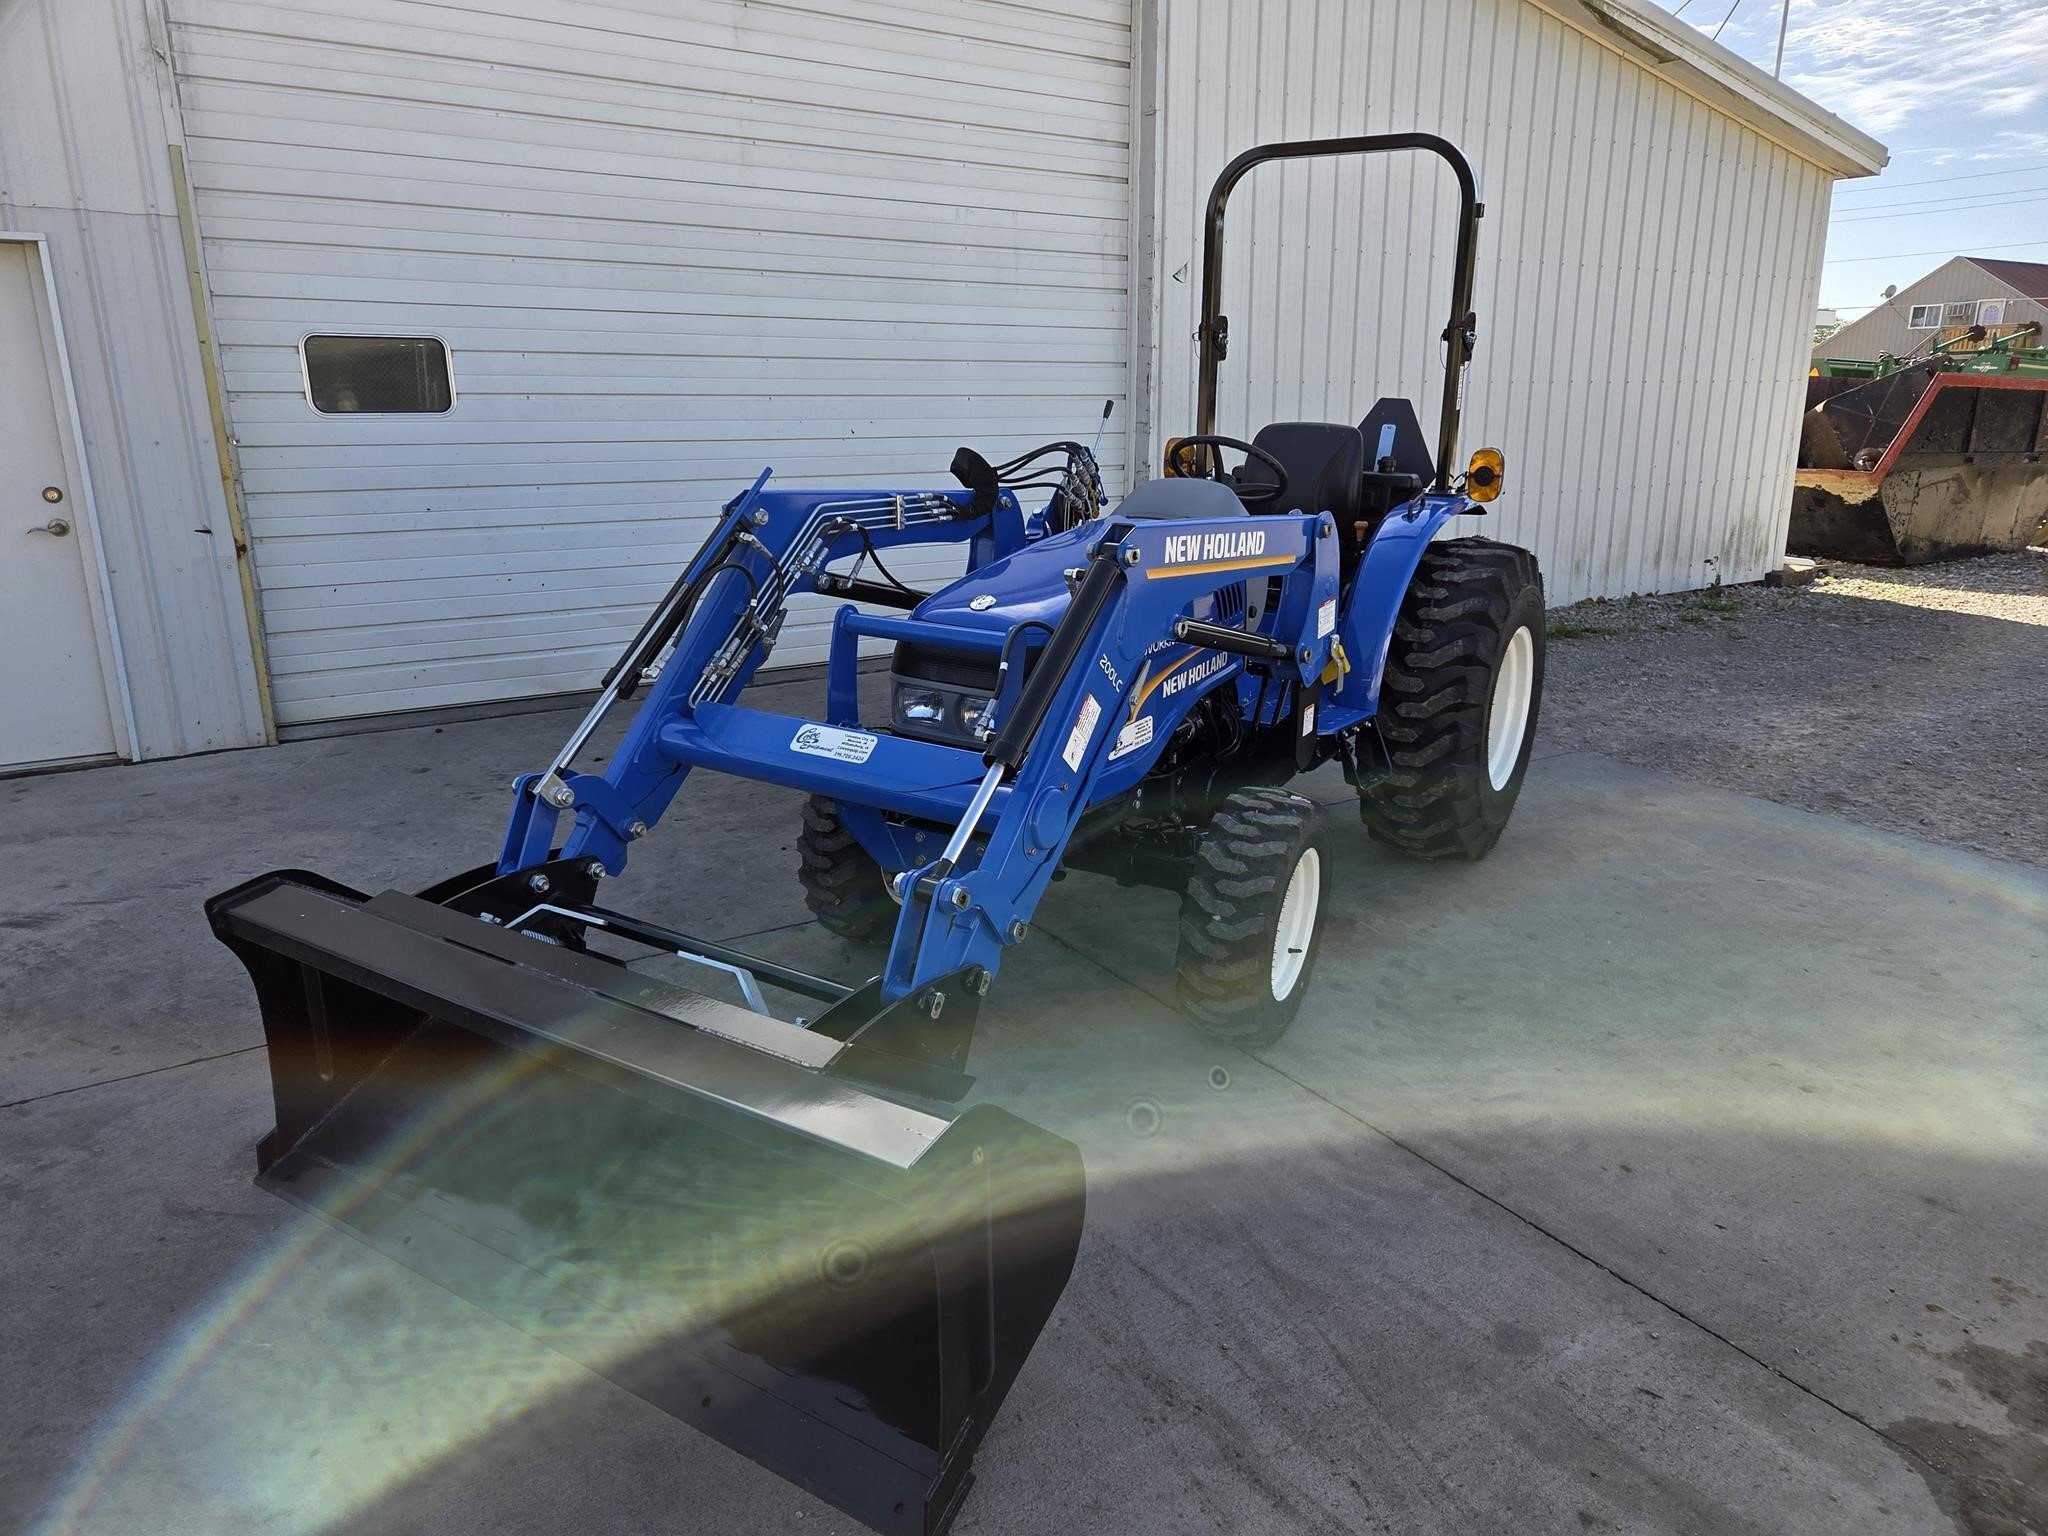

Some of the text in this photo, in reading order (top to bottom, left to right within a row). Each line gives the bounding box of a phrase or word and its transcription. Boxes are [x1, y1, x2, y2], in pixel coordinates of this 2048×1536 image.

[1164, 531, 1265, 564] NEW HOLLAND
[1099, 653, 1124, 693] 200LC
[1162, 651, 1228, 698] NEW HOLLAND
[799, 741, 834, 753] Equipment
